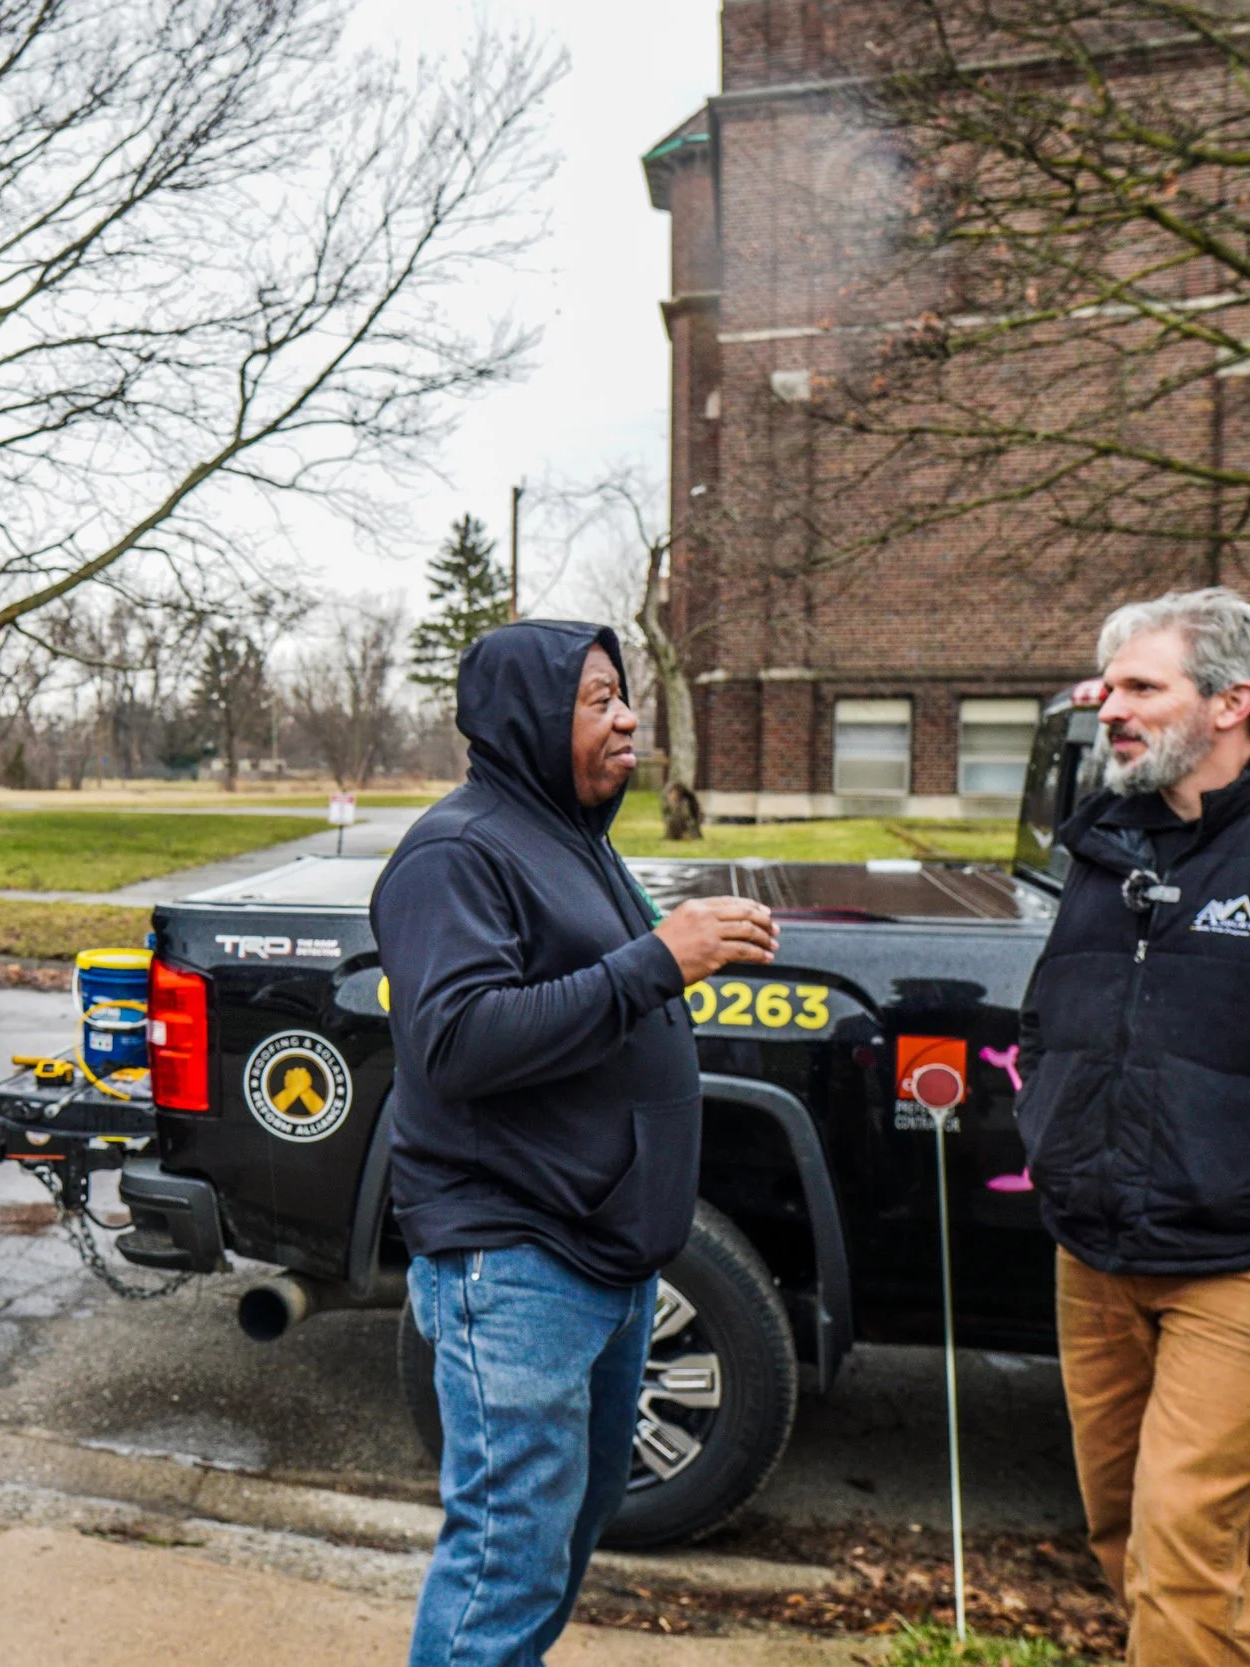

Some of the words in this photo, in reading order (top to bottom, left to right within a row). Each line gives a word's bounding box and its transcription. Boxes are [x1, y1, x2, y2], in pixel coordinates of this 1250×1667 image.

[215, 935, 292, 959] TRD
[684, 980, 829, 1030] 0263
[251, 1036, 300, 1078] ROOFING
[303, 1038, 312, 1049] &
[315, 1043, 344, 1083] SOLAR
[252, 1090, 293, 1134] REFORM
[295, 1098, 344, 1136] ALLIANCE
